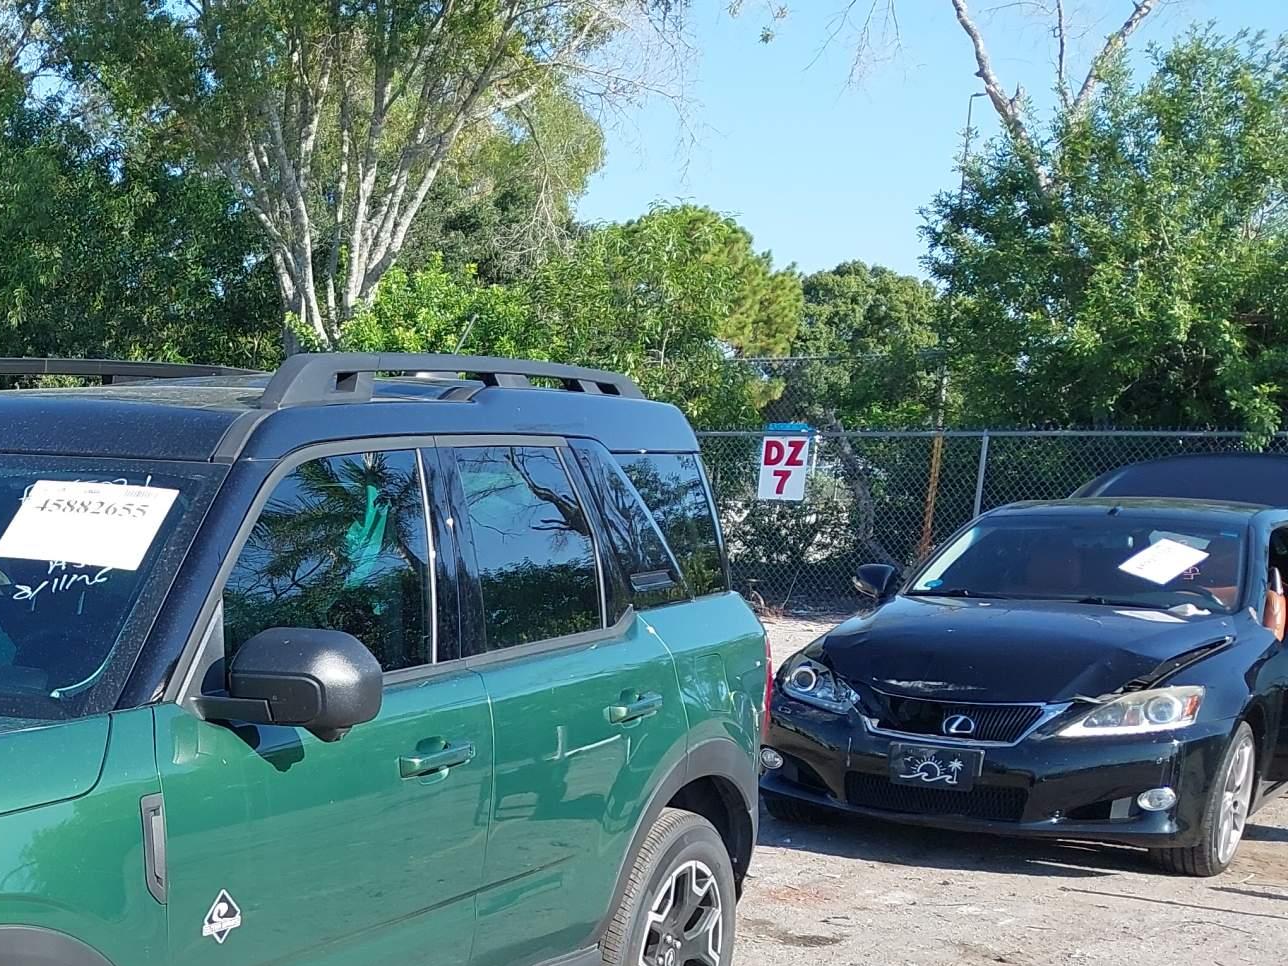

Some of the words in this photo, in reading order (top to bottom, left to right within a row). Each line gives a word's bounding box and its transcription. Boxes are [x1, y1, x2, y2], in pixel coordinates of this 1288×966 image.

[763, 439, 808, 467] DZ
[772, 469, 793, 496] 7
[32, 497, 151, 519] 45882655
